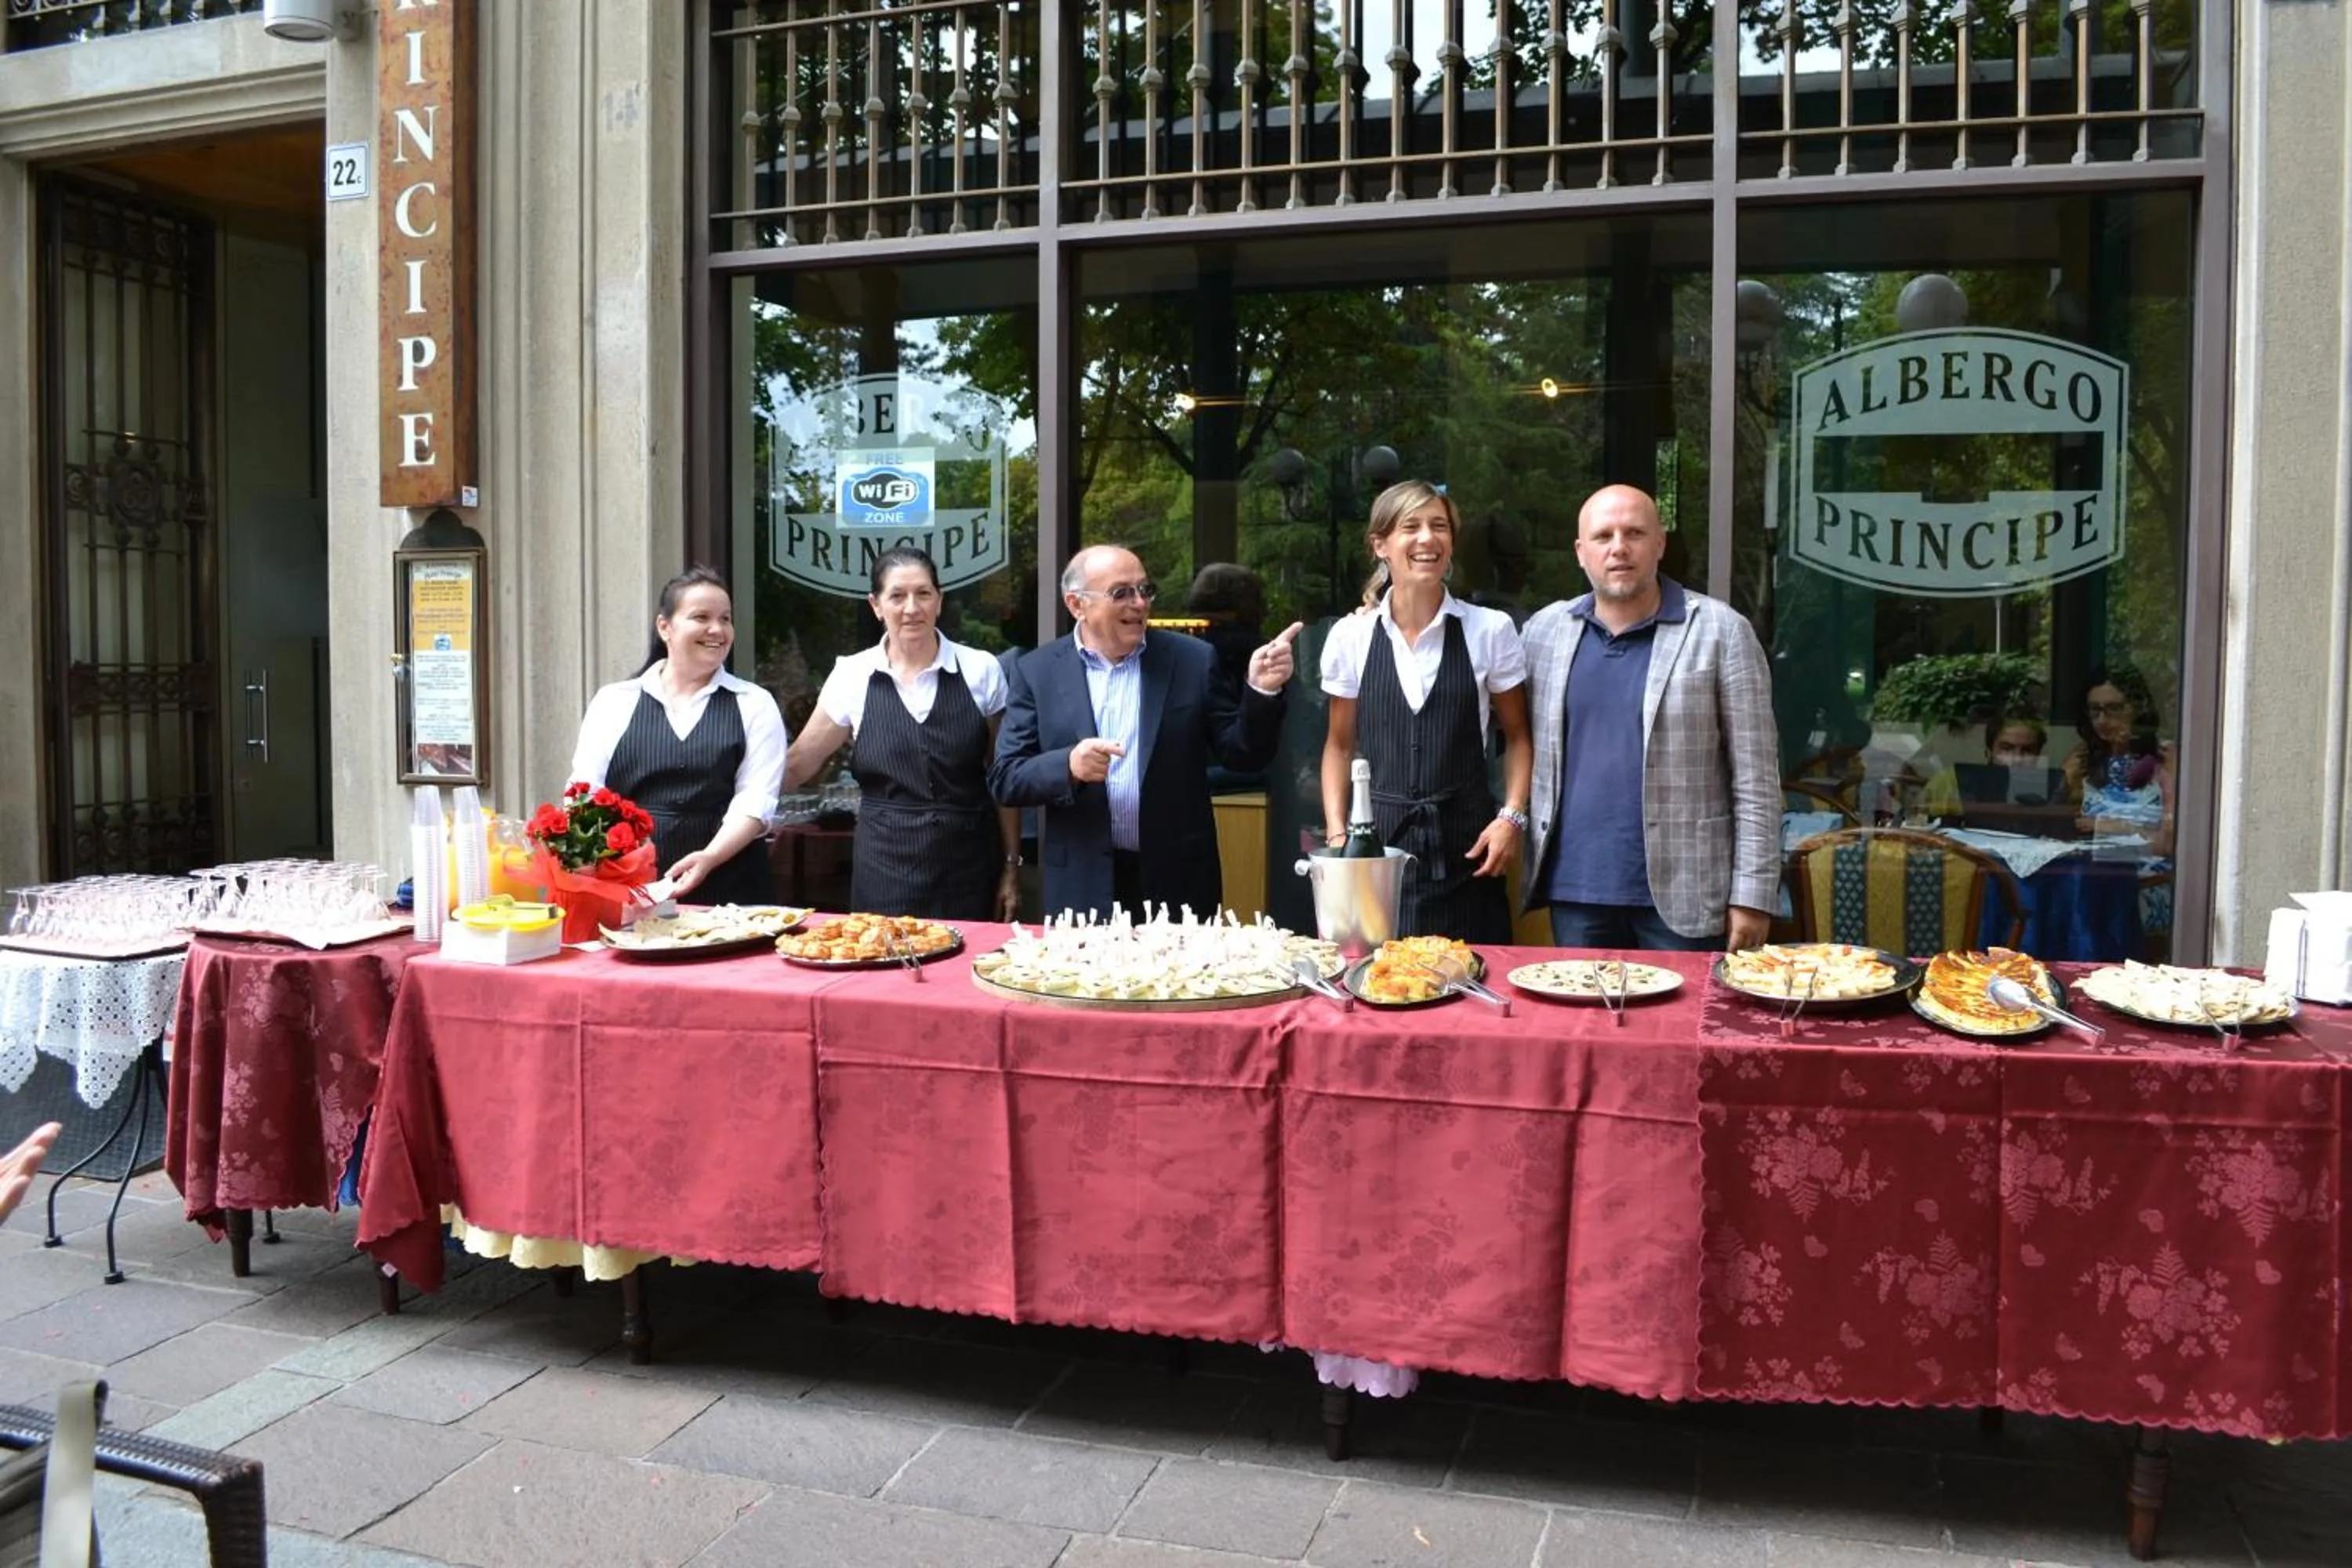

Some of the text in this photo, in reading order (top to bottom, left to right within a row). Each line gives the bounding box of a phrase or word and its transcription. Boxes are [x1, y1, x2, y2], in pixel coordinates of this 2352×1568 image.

[393, 0, 439, 466] INCIPE
[1817, 351, 2102, 432] ALBERGO
[866, 452, 903, 464] FREE
[786, 511, 990, 576] PRINIPE
[866, 512, 904, 523] ZONE
[1814, 493, 2099, 571] PRINCIPE
